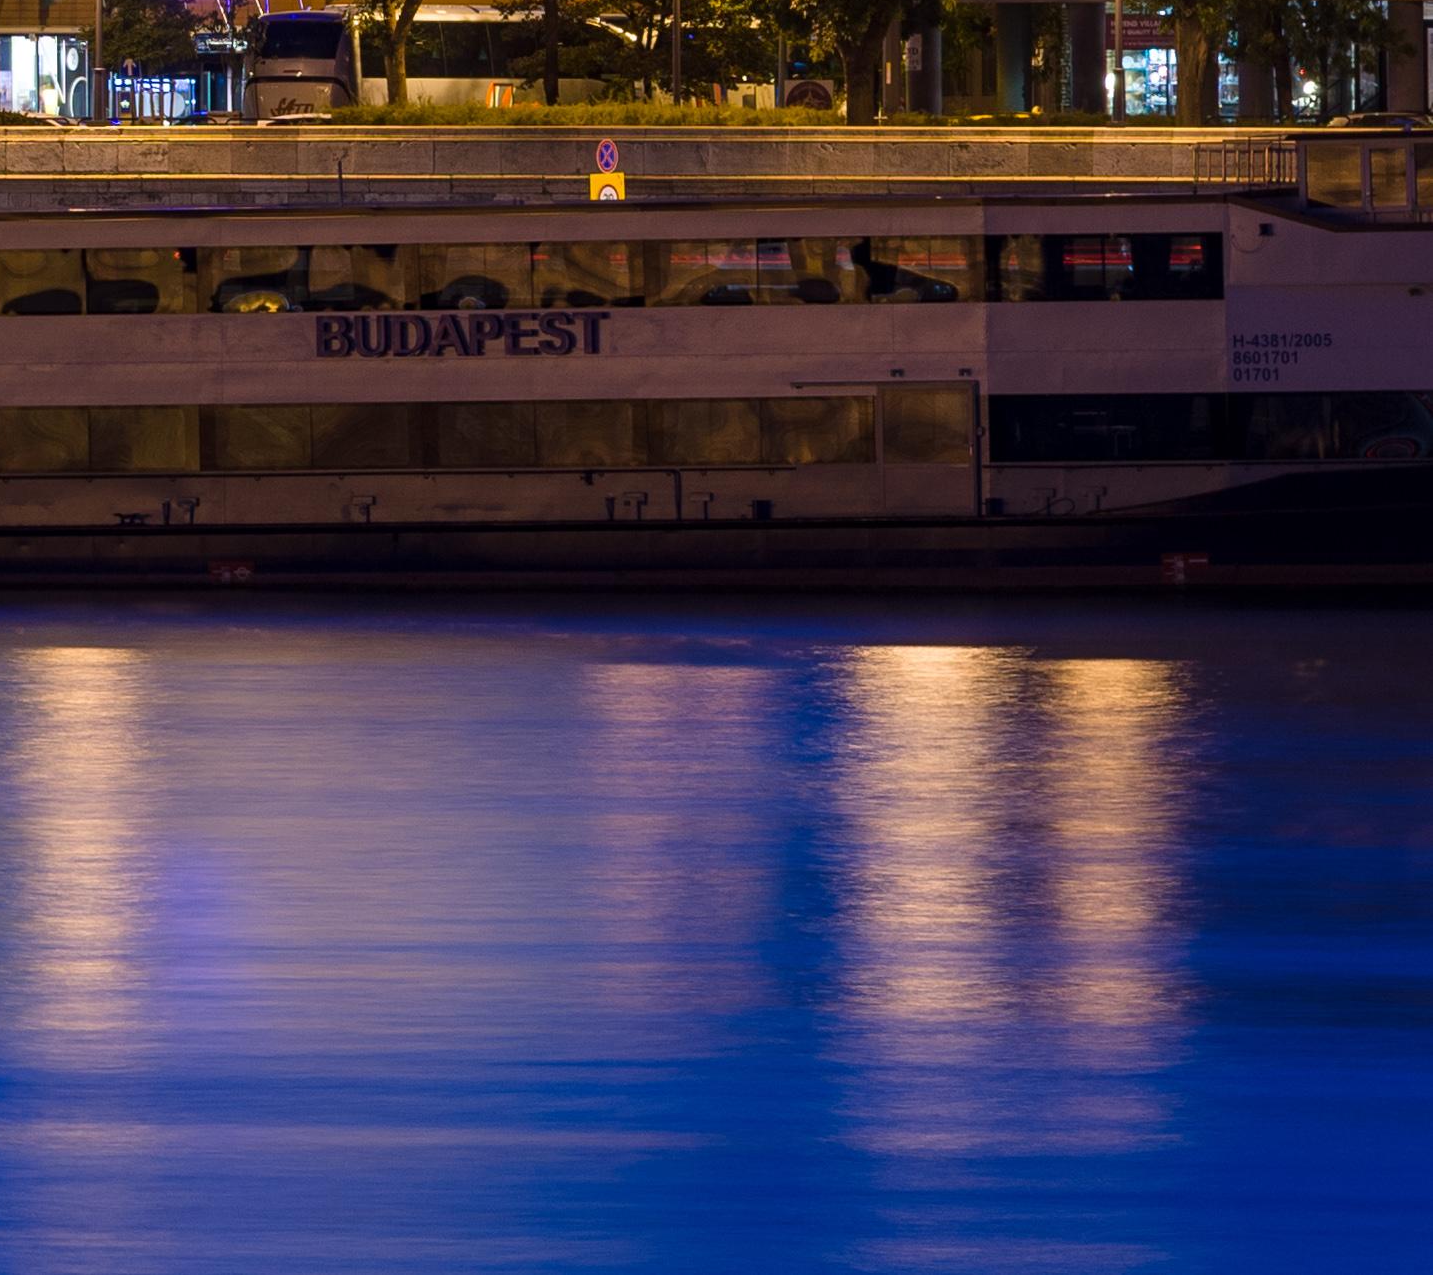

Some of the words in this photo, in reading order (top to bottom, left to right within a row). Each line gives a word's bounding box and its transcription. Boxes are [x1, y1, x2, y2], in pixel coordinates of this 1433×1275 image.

[315, 310, 610, 358] BUDAPEST
[1232, 332, 1333, 348] H-4381/2005
[1232, 350, 1300, 365] 8601701
[1232, 367, 1281, 382] 01701
